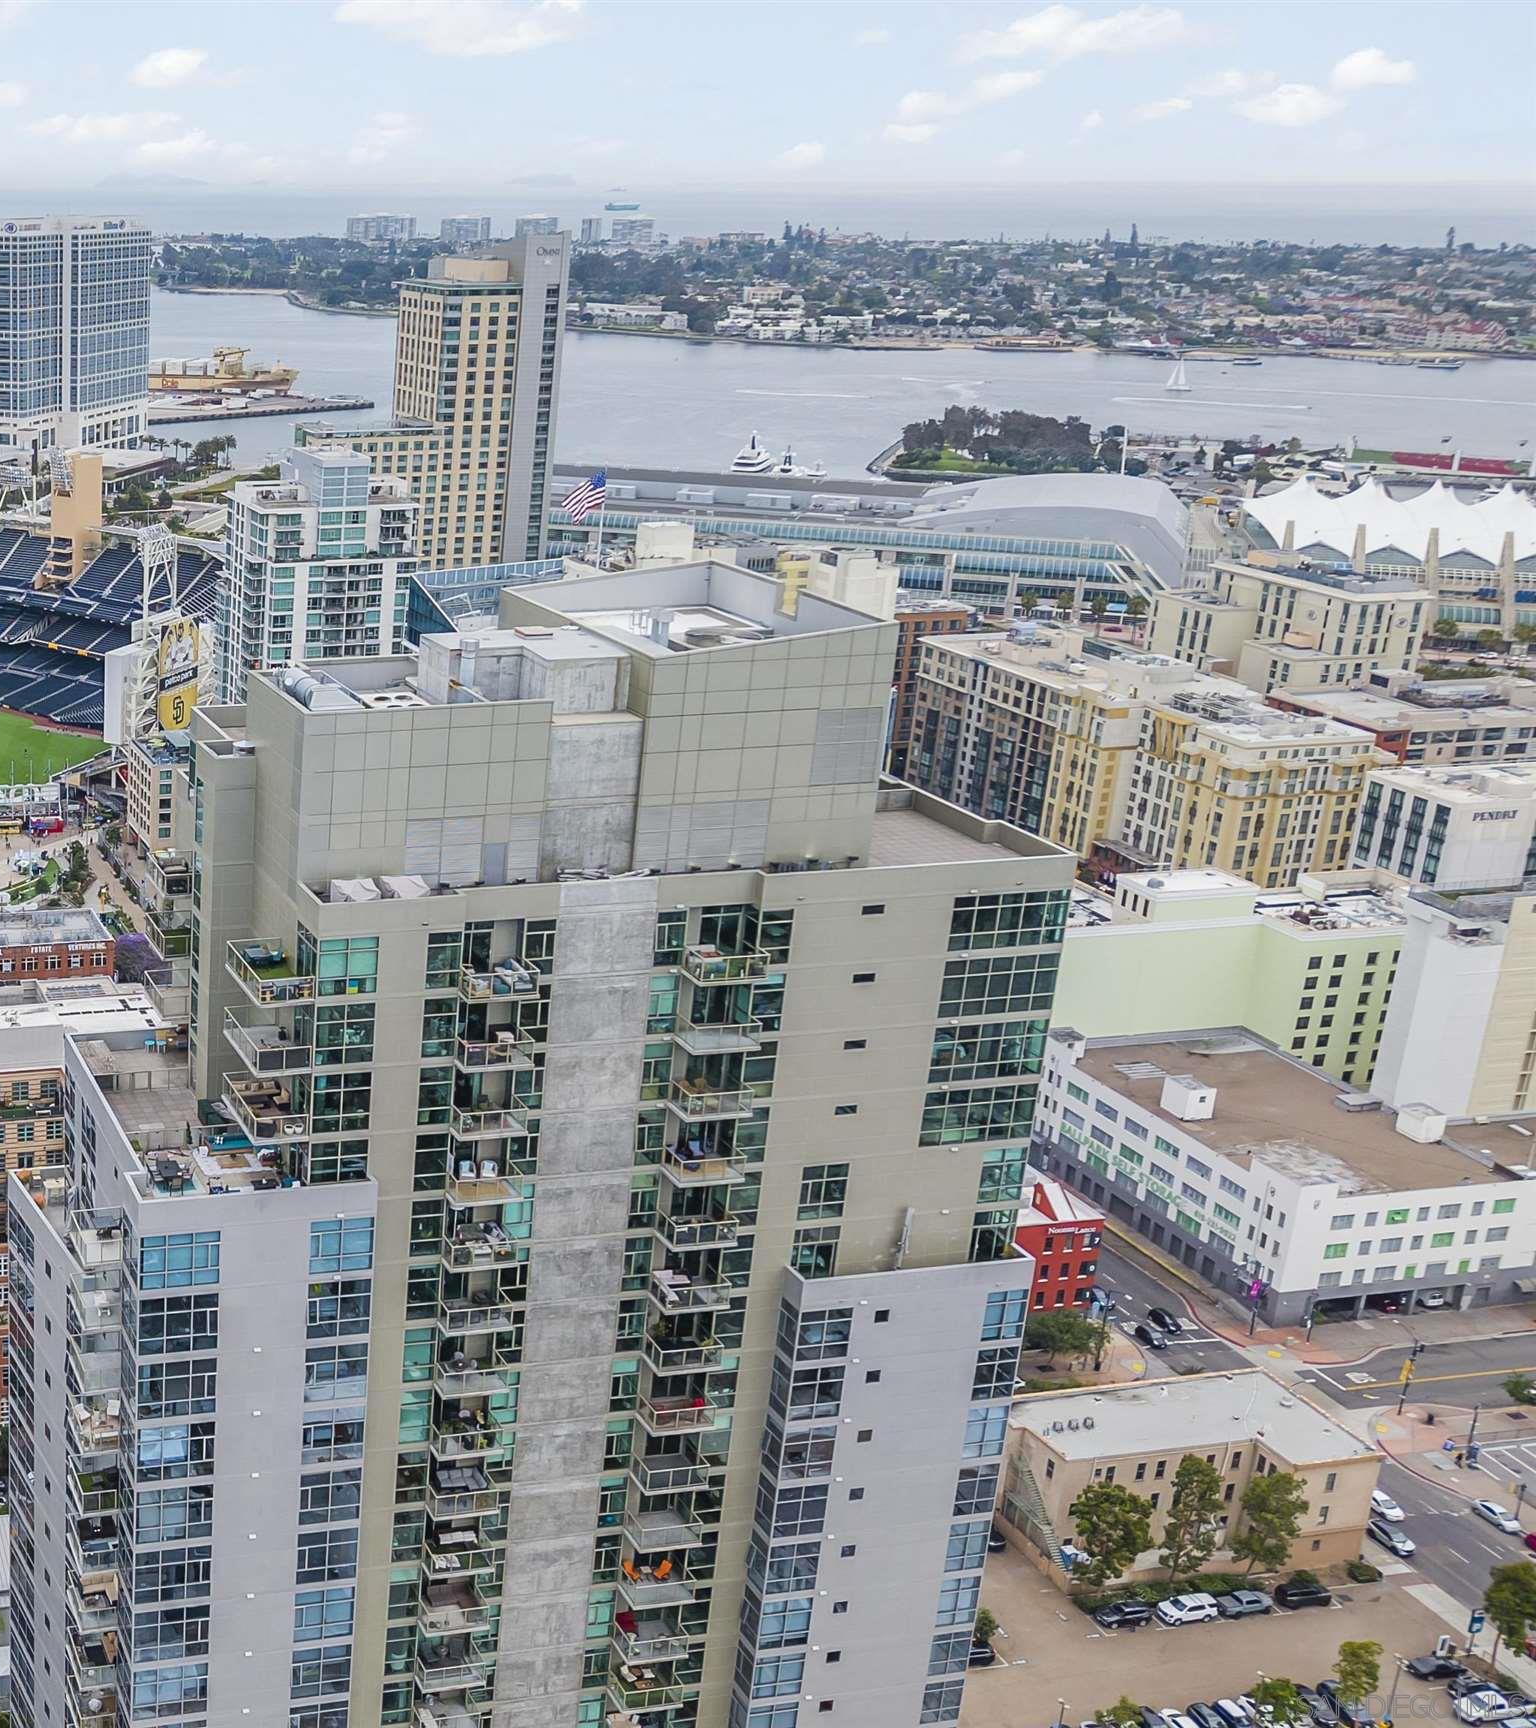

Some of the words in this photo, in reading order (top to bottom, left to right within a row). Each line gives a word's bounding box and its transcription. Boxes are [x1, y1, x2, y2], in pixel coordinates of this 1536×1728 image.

[1060, 1121, 1111, 1162] BALLPARK
[1111, 1155, 1136, 1176] SELF
[1138, 1174, 1186, 1208] STORAG
